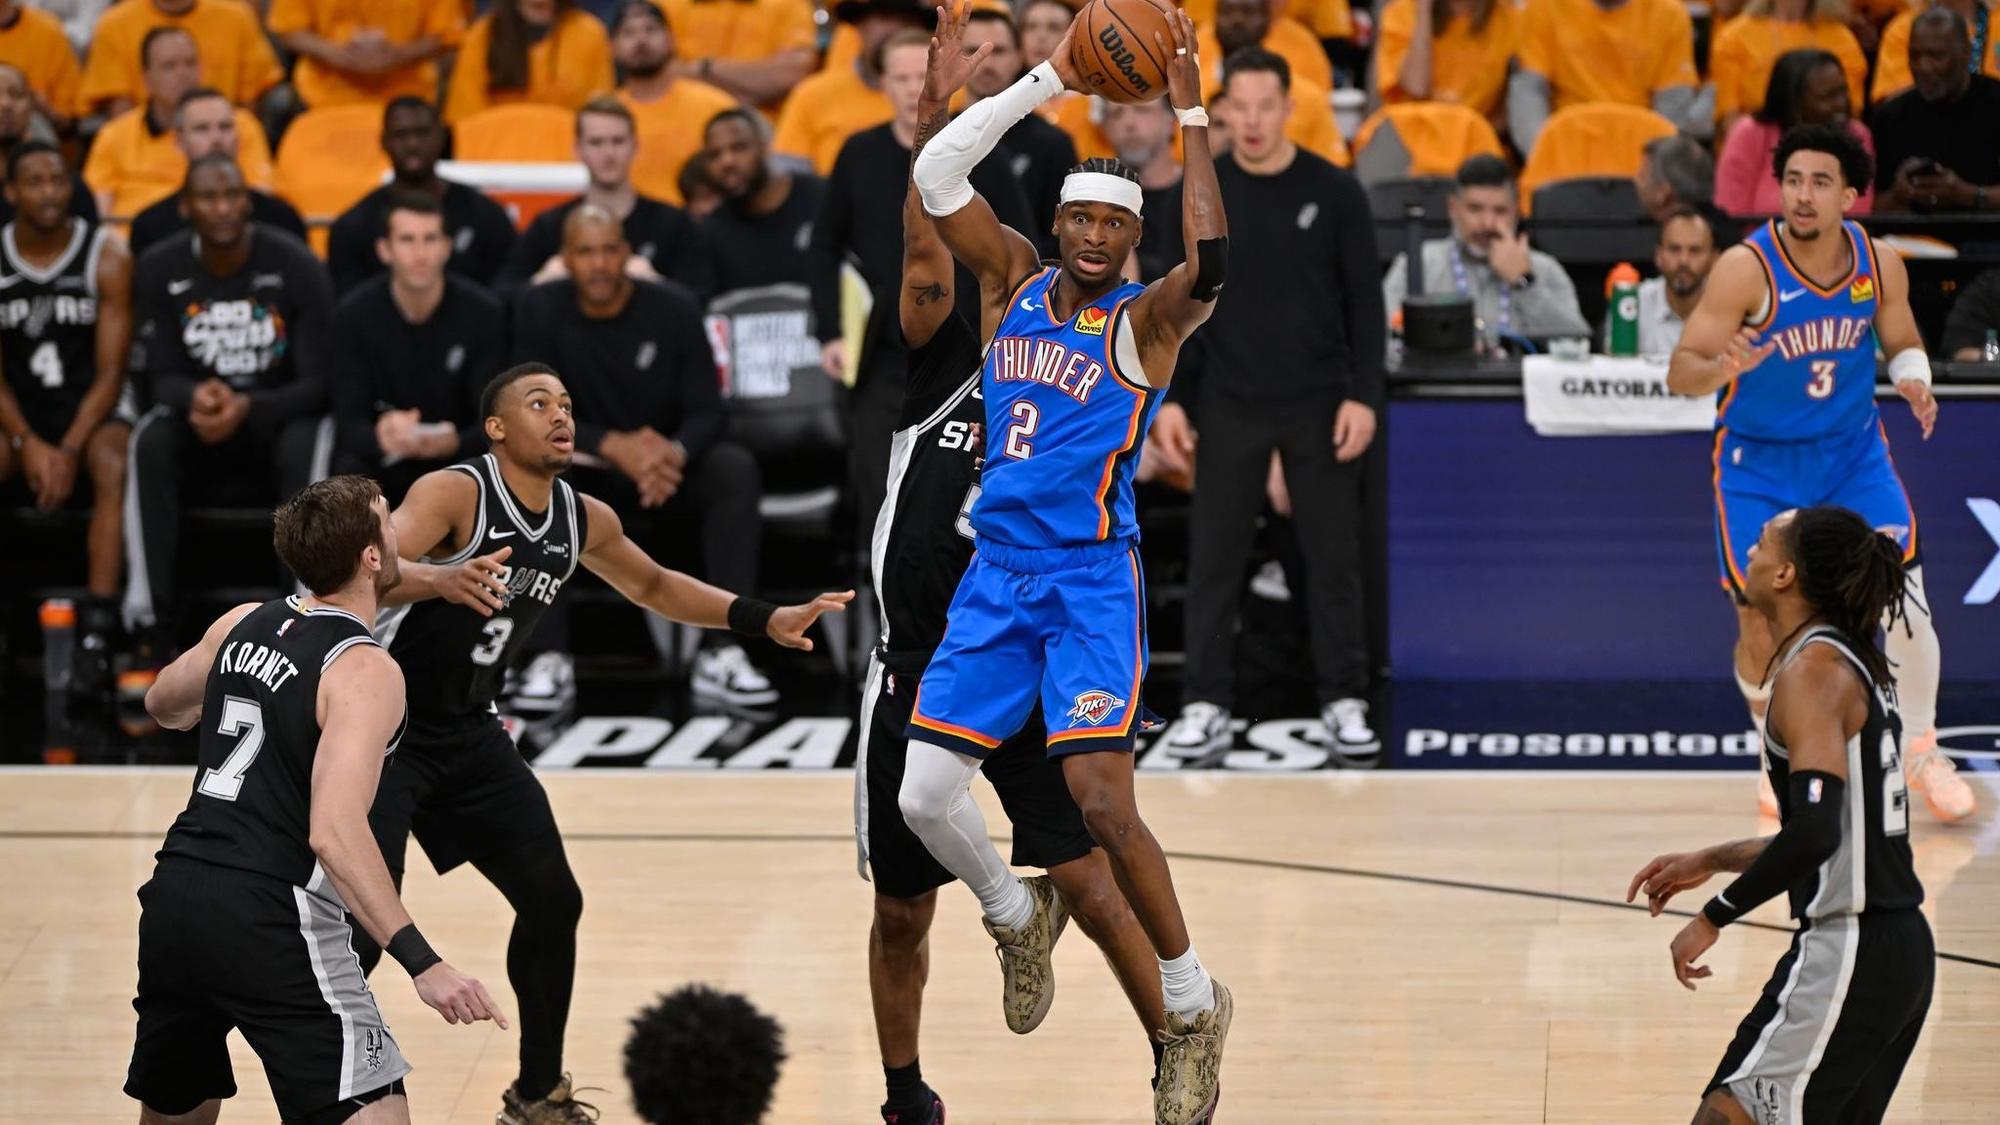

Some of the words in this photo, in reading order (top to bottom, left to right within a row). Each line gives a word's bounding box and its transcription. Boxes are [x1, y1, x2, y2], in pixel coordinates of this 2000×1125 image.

[1099, 23, 1151, 95] Wilson
[1771, 317, 1870, 361] THUNDE
[30, 341, 64, 388] 4
[993, 337, 1104, 405] THUNDER
[1561, 377, 1698, 400] GATORA
[1807, 360, 1837, 399] 3
[1003, 400, 1040, 461] 2
[470, 617, 514, 666] 3
[220, 641, 299, 693] KORNET
[197, 694, 266, 802] 7
[1405, 729, 1761, 757] Presented
